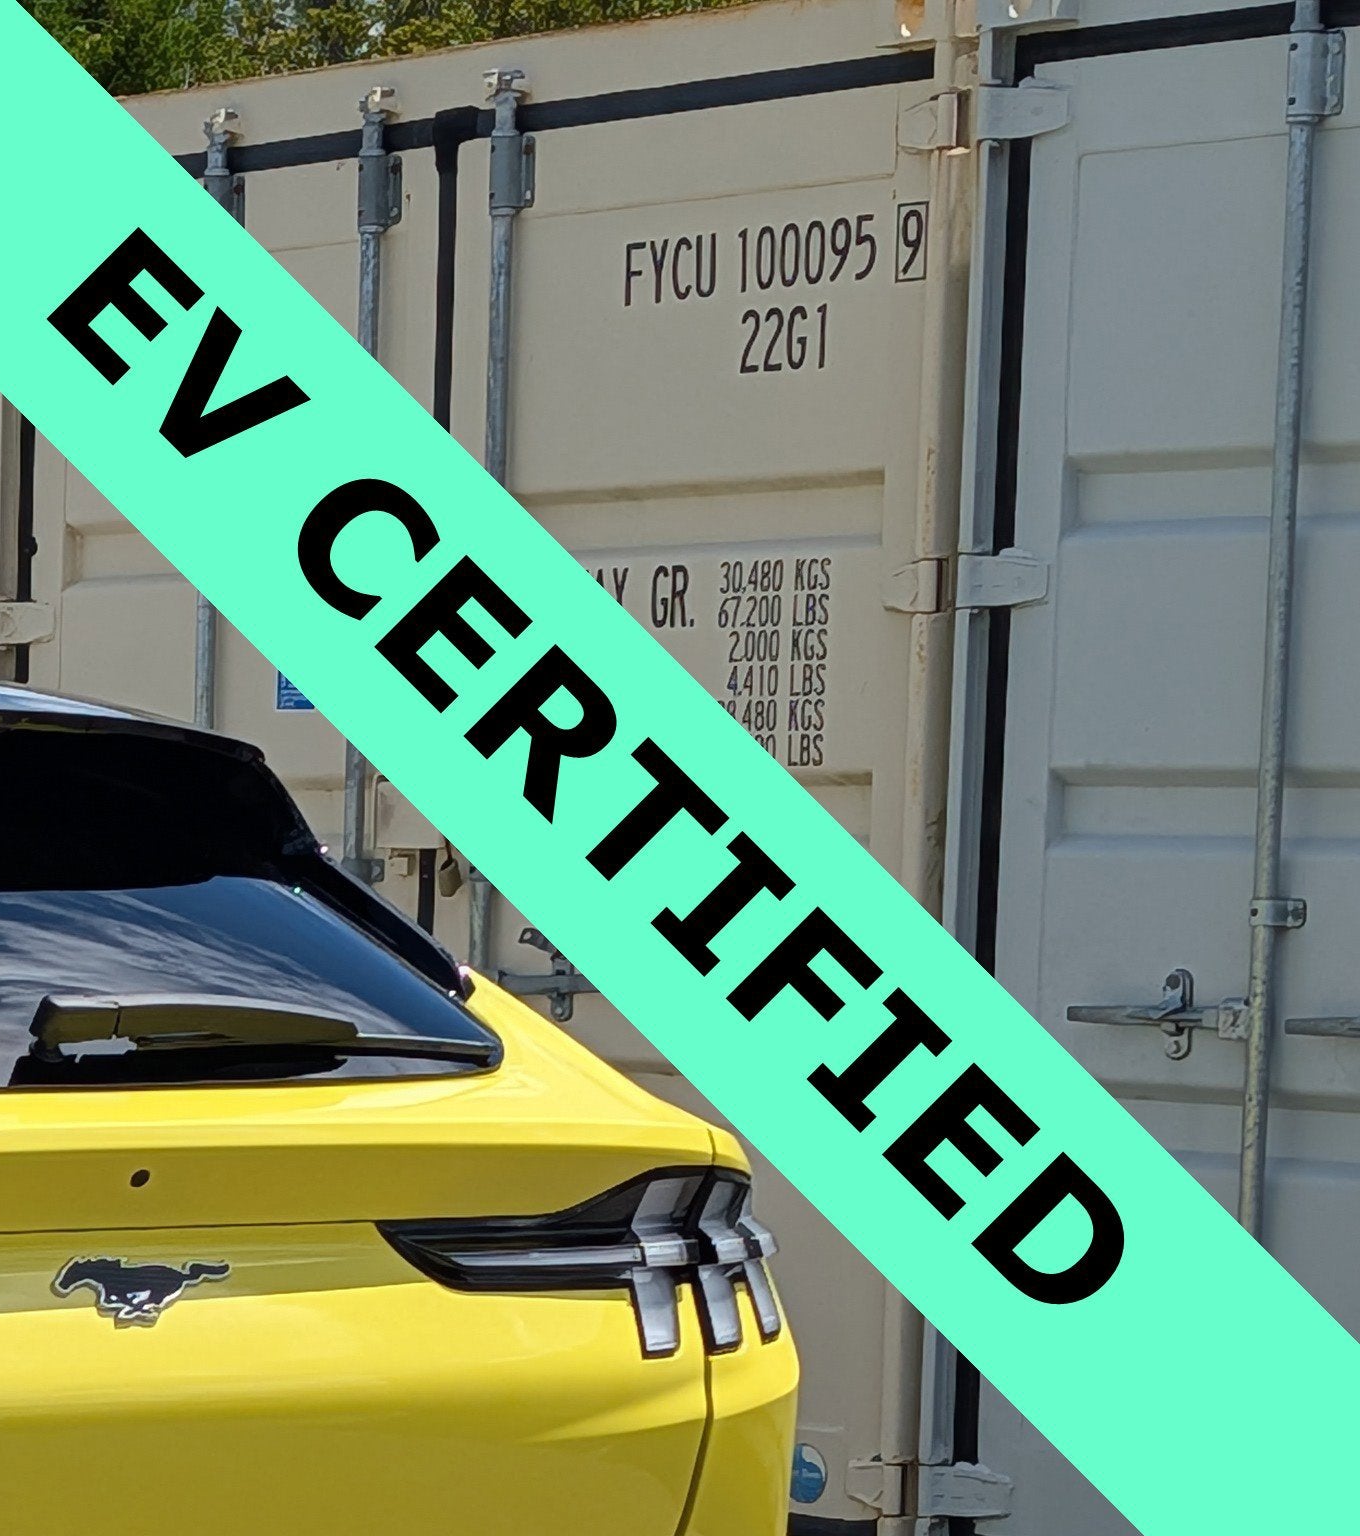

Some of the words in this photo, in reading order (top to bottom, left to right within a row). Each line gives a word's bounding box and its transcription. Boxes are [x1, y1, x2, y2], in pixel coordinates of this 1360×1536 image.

[624, 232, 717, 307] FYCU
[738, 213, 877, 293] 100095
[899, 206, 925, 277] 9
[739, 303, 828, 374] 22G1
[793, 557, 832, 592] KGS
[650, 564, 695, 629] GR.
[792, 593, 830, 627] LBS
[790, 628, 828, 662] KGS
[789, 663, 827, 697] LBS
[787, 698, 826, 732] KGS
[786, 733, 824, 767] LBS
